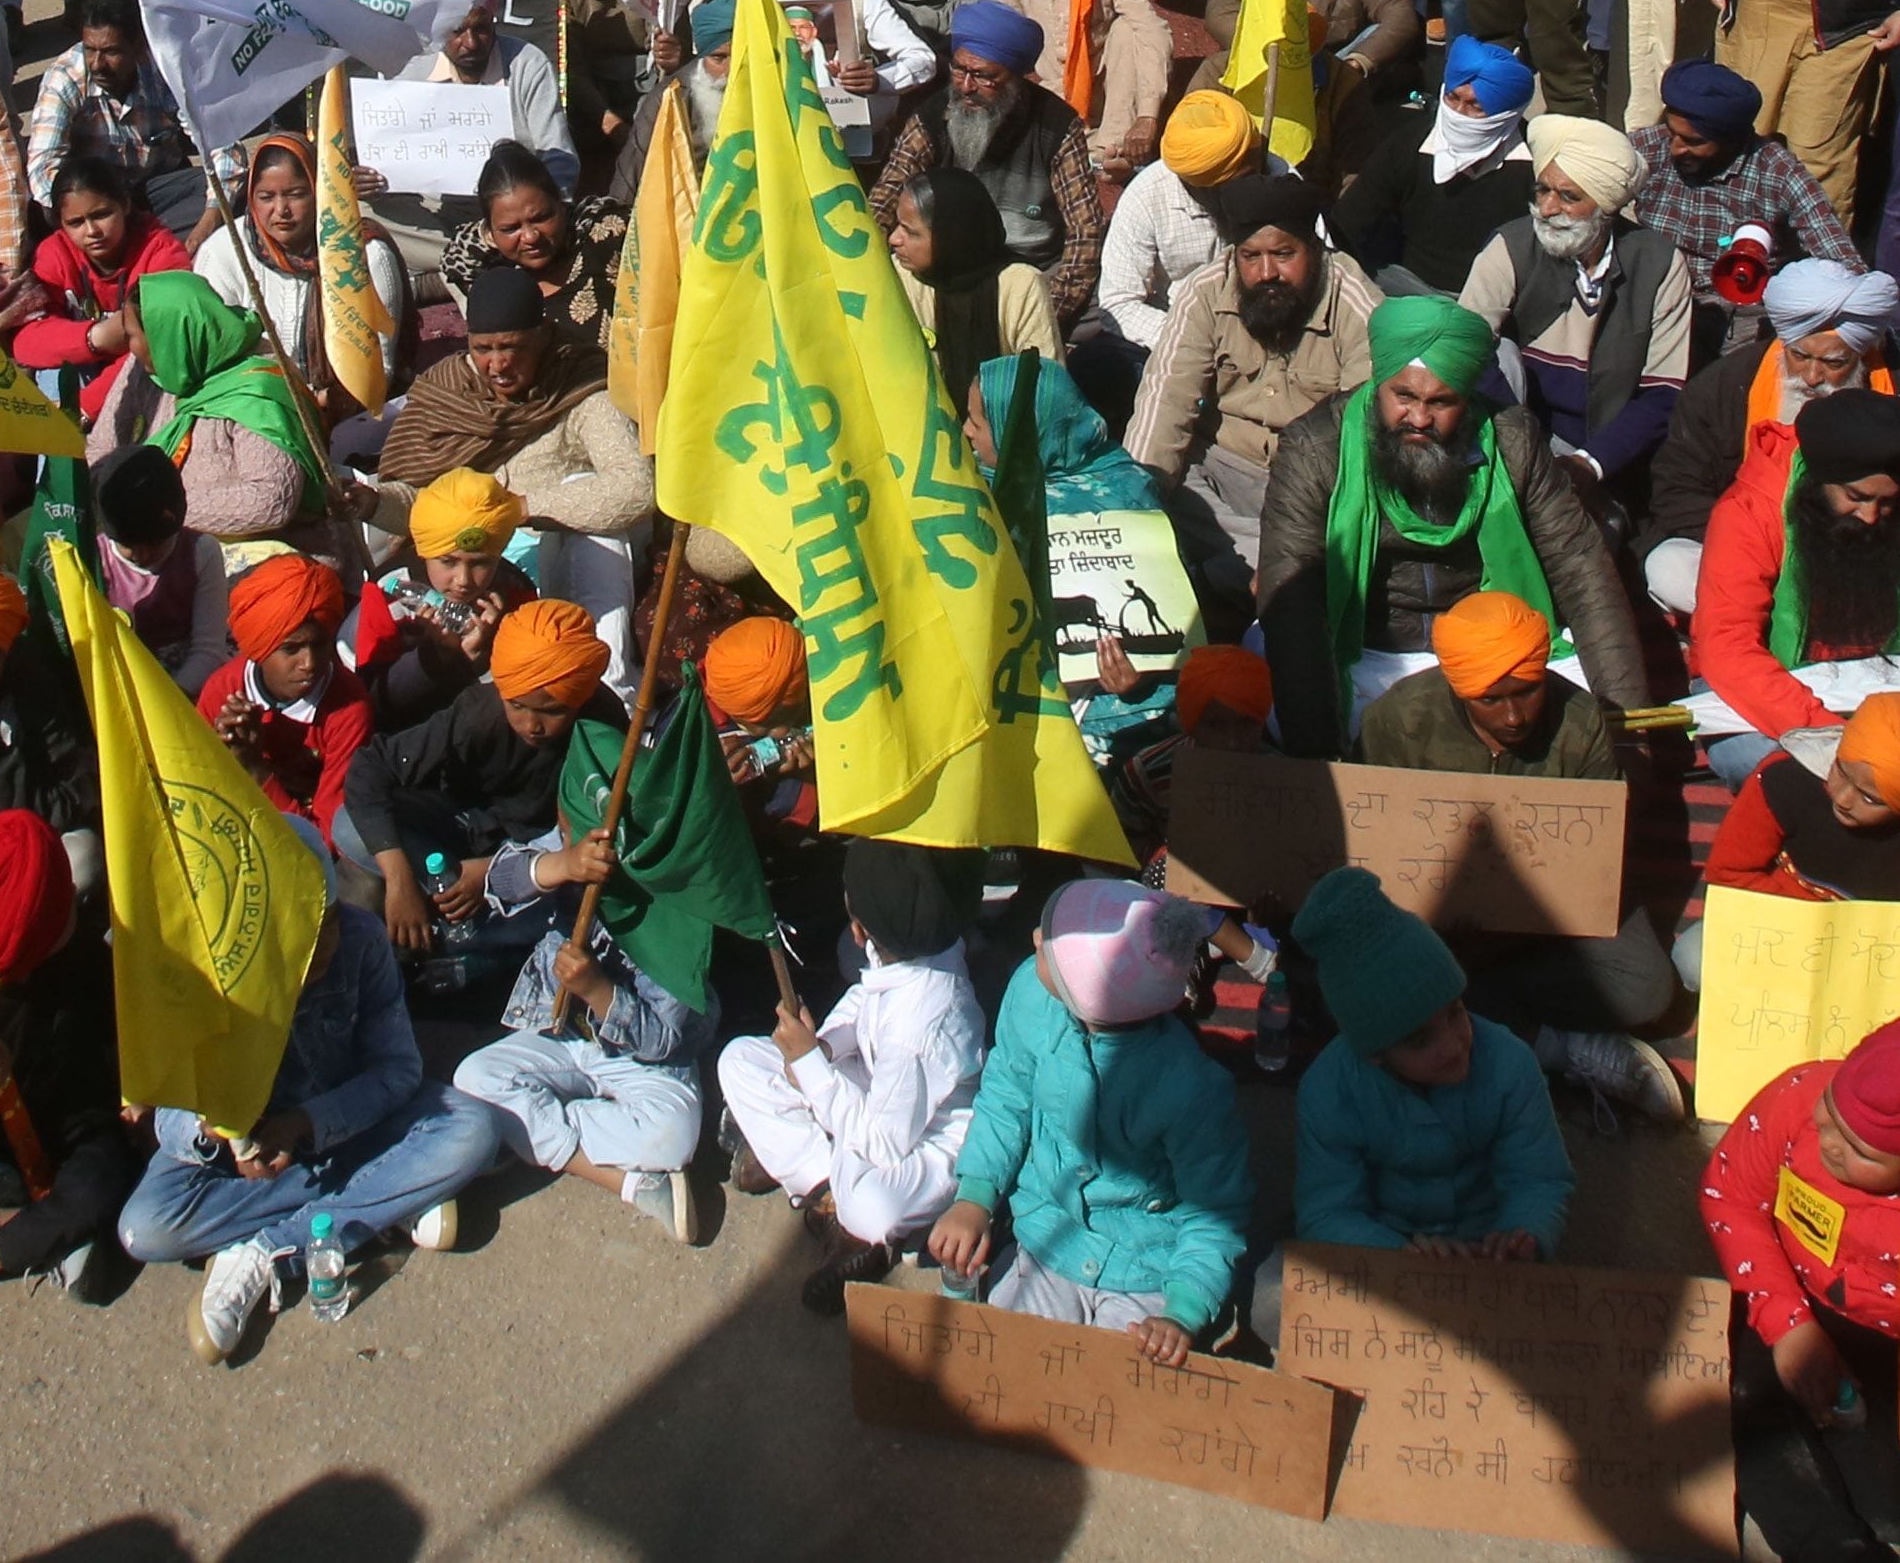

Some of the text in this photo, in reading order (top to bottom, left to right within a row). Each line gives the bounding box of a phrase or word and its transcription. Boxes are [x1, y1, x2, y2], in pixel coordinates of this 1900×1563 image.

[235, 43, 254, 69] NO
[1073, 527, 1123, 550] ਮਜ਼ਦੂਰ
[1069, 551, 1137, 573] ਜ਼ਿੰਦਾਬਾਦ
[1788, 1187, 1834, 1230] FARMER
[1793, 1186, 1827, 1214] PROUD
